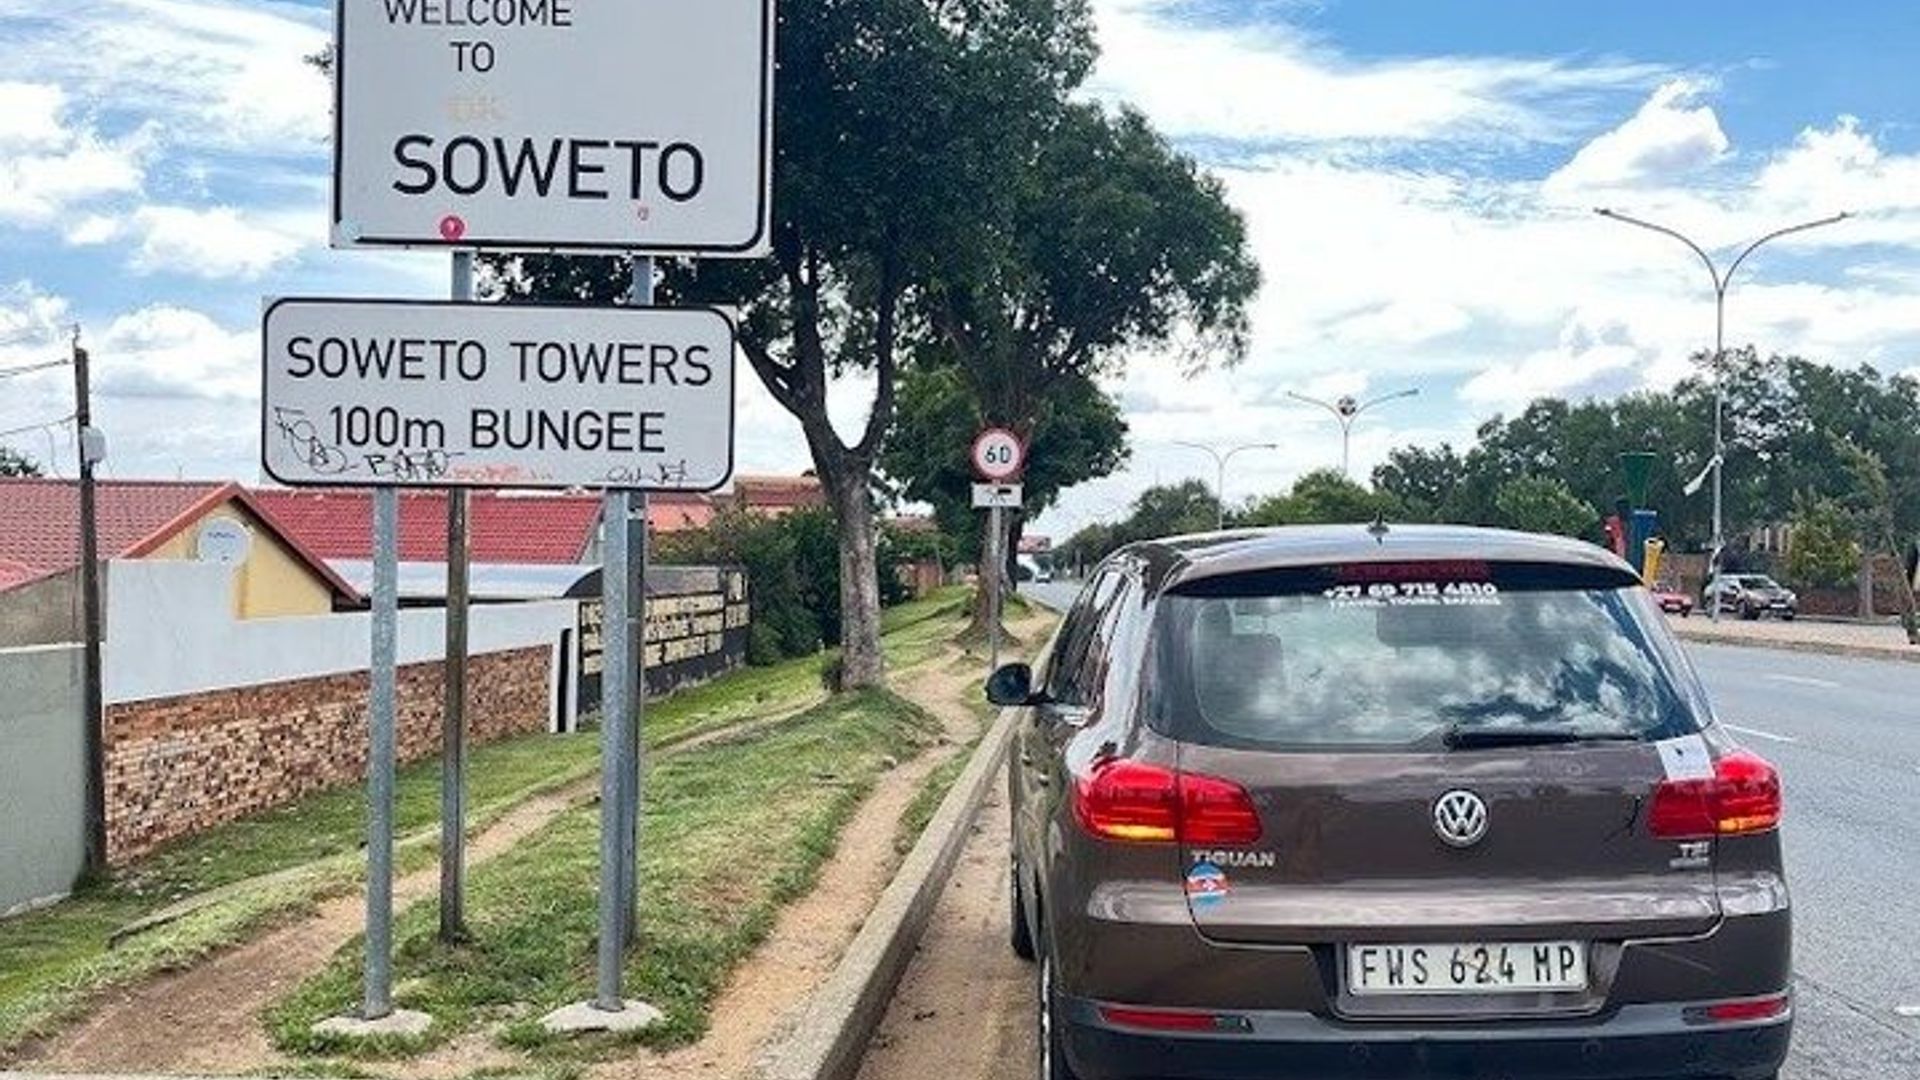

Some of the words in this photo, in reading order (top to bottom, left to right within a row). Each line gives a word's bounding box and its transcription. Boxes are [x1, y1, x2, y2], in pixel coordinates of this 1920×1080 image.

[385, 0, 572, 27] WELCOME
[450, 41, 495, 73] TO
[392, 134, 704, 202] SOWETO
[286, 336, 487, 382] SOWETO
[510, 341, 712, 386] TOWERS
[330, 405, 445, 448] 100m
[471, 409, 665, 453] BUNGEE
[985, 444, 1013, 464] 60
[1192, 850, 1275, 867] TIGUAN
[1361, 949, 1428, 986] FWS
[1450, 947, 1515, 984] 624
[1533, 945, 1575, 982] MP
